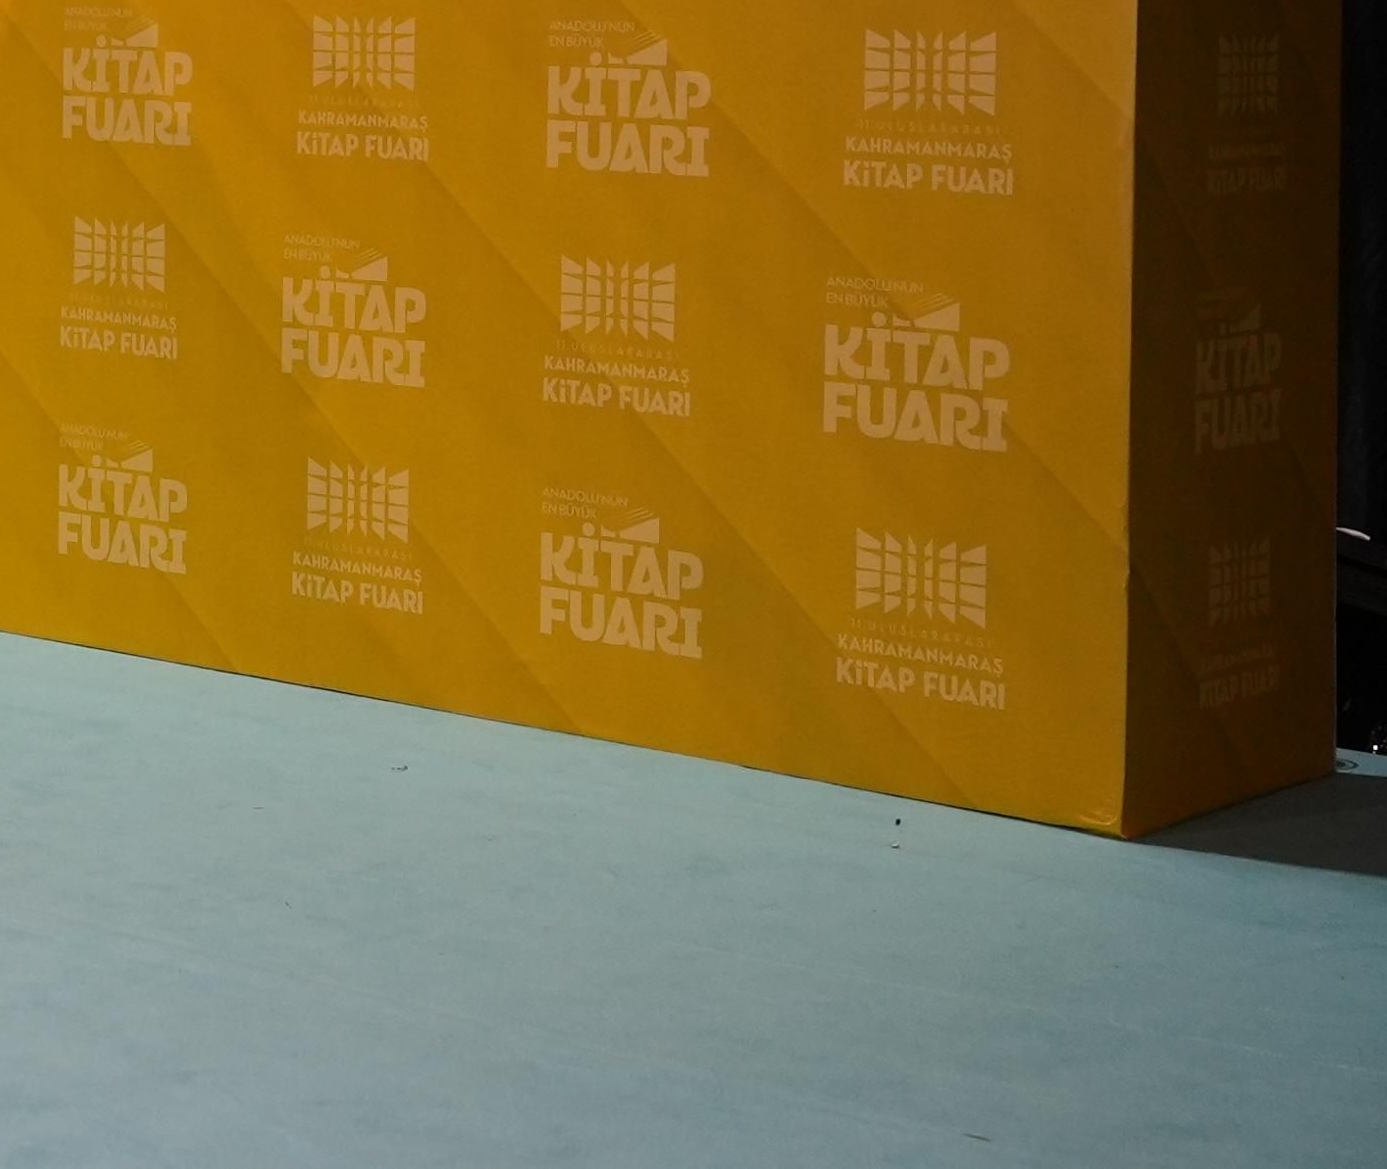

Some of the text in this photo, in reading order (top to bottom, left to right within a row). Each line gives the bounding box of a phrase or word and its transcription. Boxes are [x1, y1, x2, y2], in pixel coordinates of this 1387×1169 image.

[61, 96, 193, 146] FUARI
[546, 119, 710, 177] FUARI
[281, 329, 426, 388] FUARI
[823, 381, 1009, 452] FUARI
[57, 512, 189, 574] FUARI
[538, 588, 703, 660] FUARI
